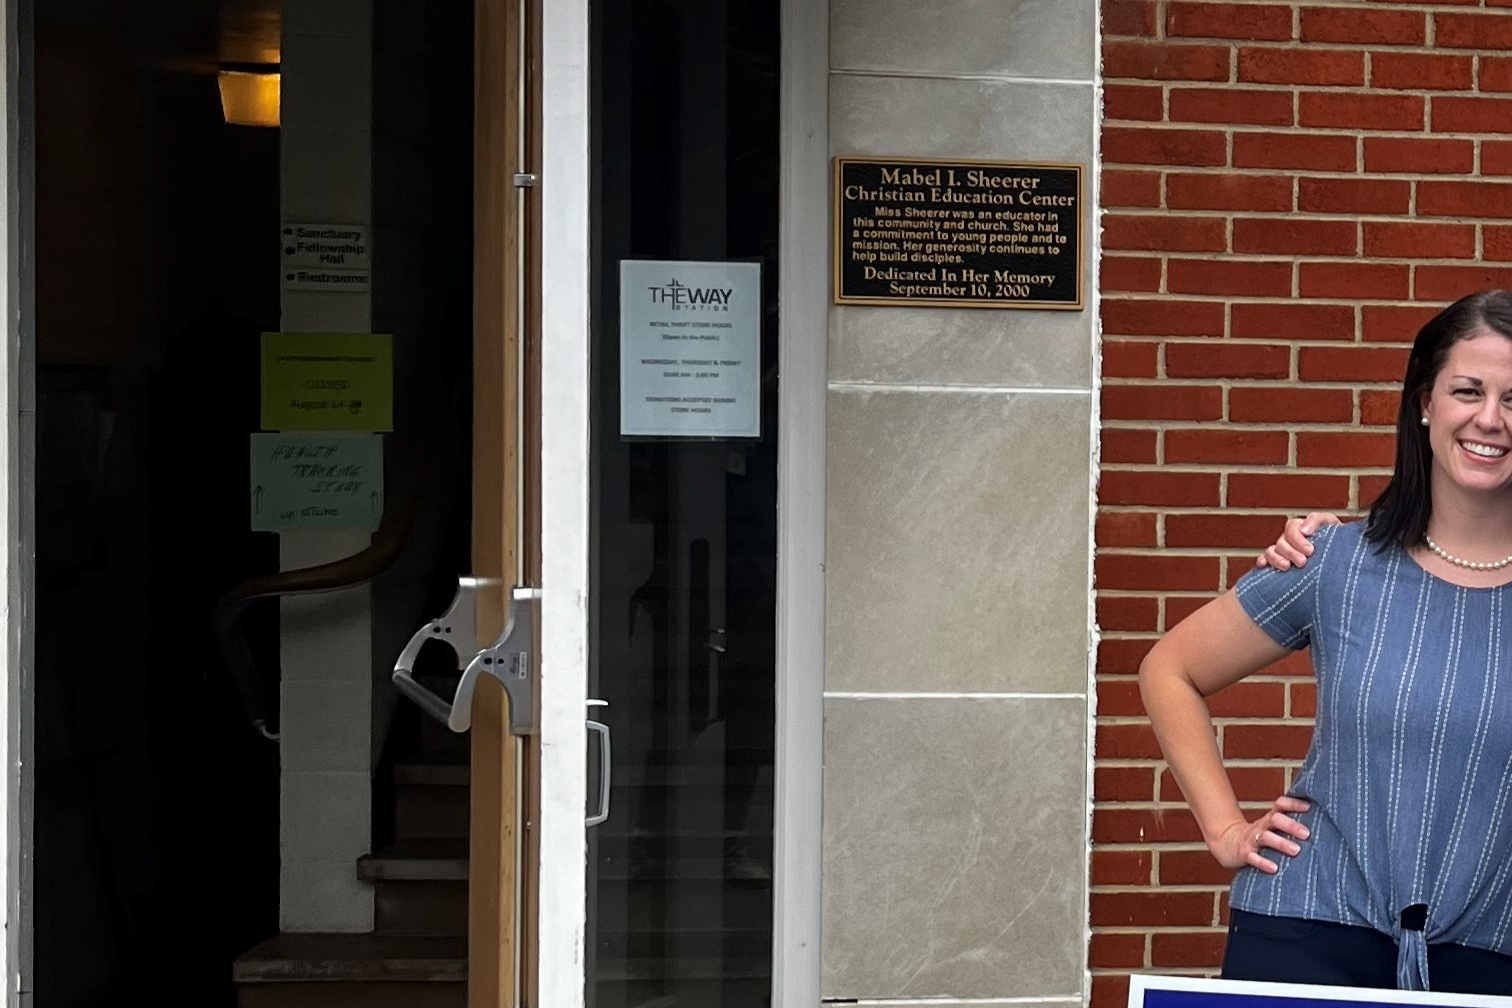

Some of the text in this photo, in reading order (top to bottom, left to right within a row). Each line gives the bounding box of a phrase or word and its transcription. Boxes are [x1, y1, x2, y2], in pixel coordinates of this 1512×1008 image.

[881, 168, 1040, 189] Mabel I. Sheerer
[845, 185, 1074, 207] Christian Education Center
[875, 207, 901, 217] Miss
[904, 207, 950, 218] Sheerer
[953, 210, 974, 219] was
[995, 210, 1045, 221] educator
[1048, 211, 1058, 221] in
[853, 218, 1058, 232] this community and church. She had
[297, 228, 361, 241] Sanctuary
[863, 229, 934, 240] commitment
[937, 231, 948, 241] to
[952, 233, 986, 243] young
[990, 234, 1028, 243] people
[1032, 234, 1052, 243] and
[1055, 234, 1066, 244] to
[853, 242, 1059, 255] mission. Her generosity continues to
[853, 251, 964, 264] help build disciples.
[864, 266, 1055, 286] Dedicated In Her Memory
[890, 282, 1030, 298] September 10, 2000
